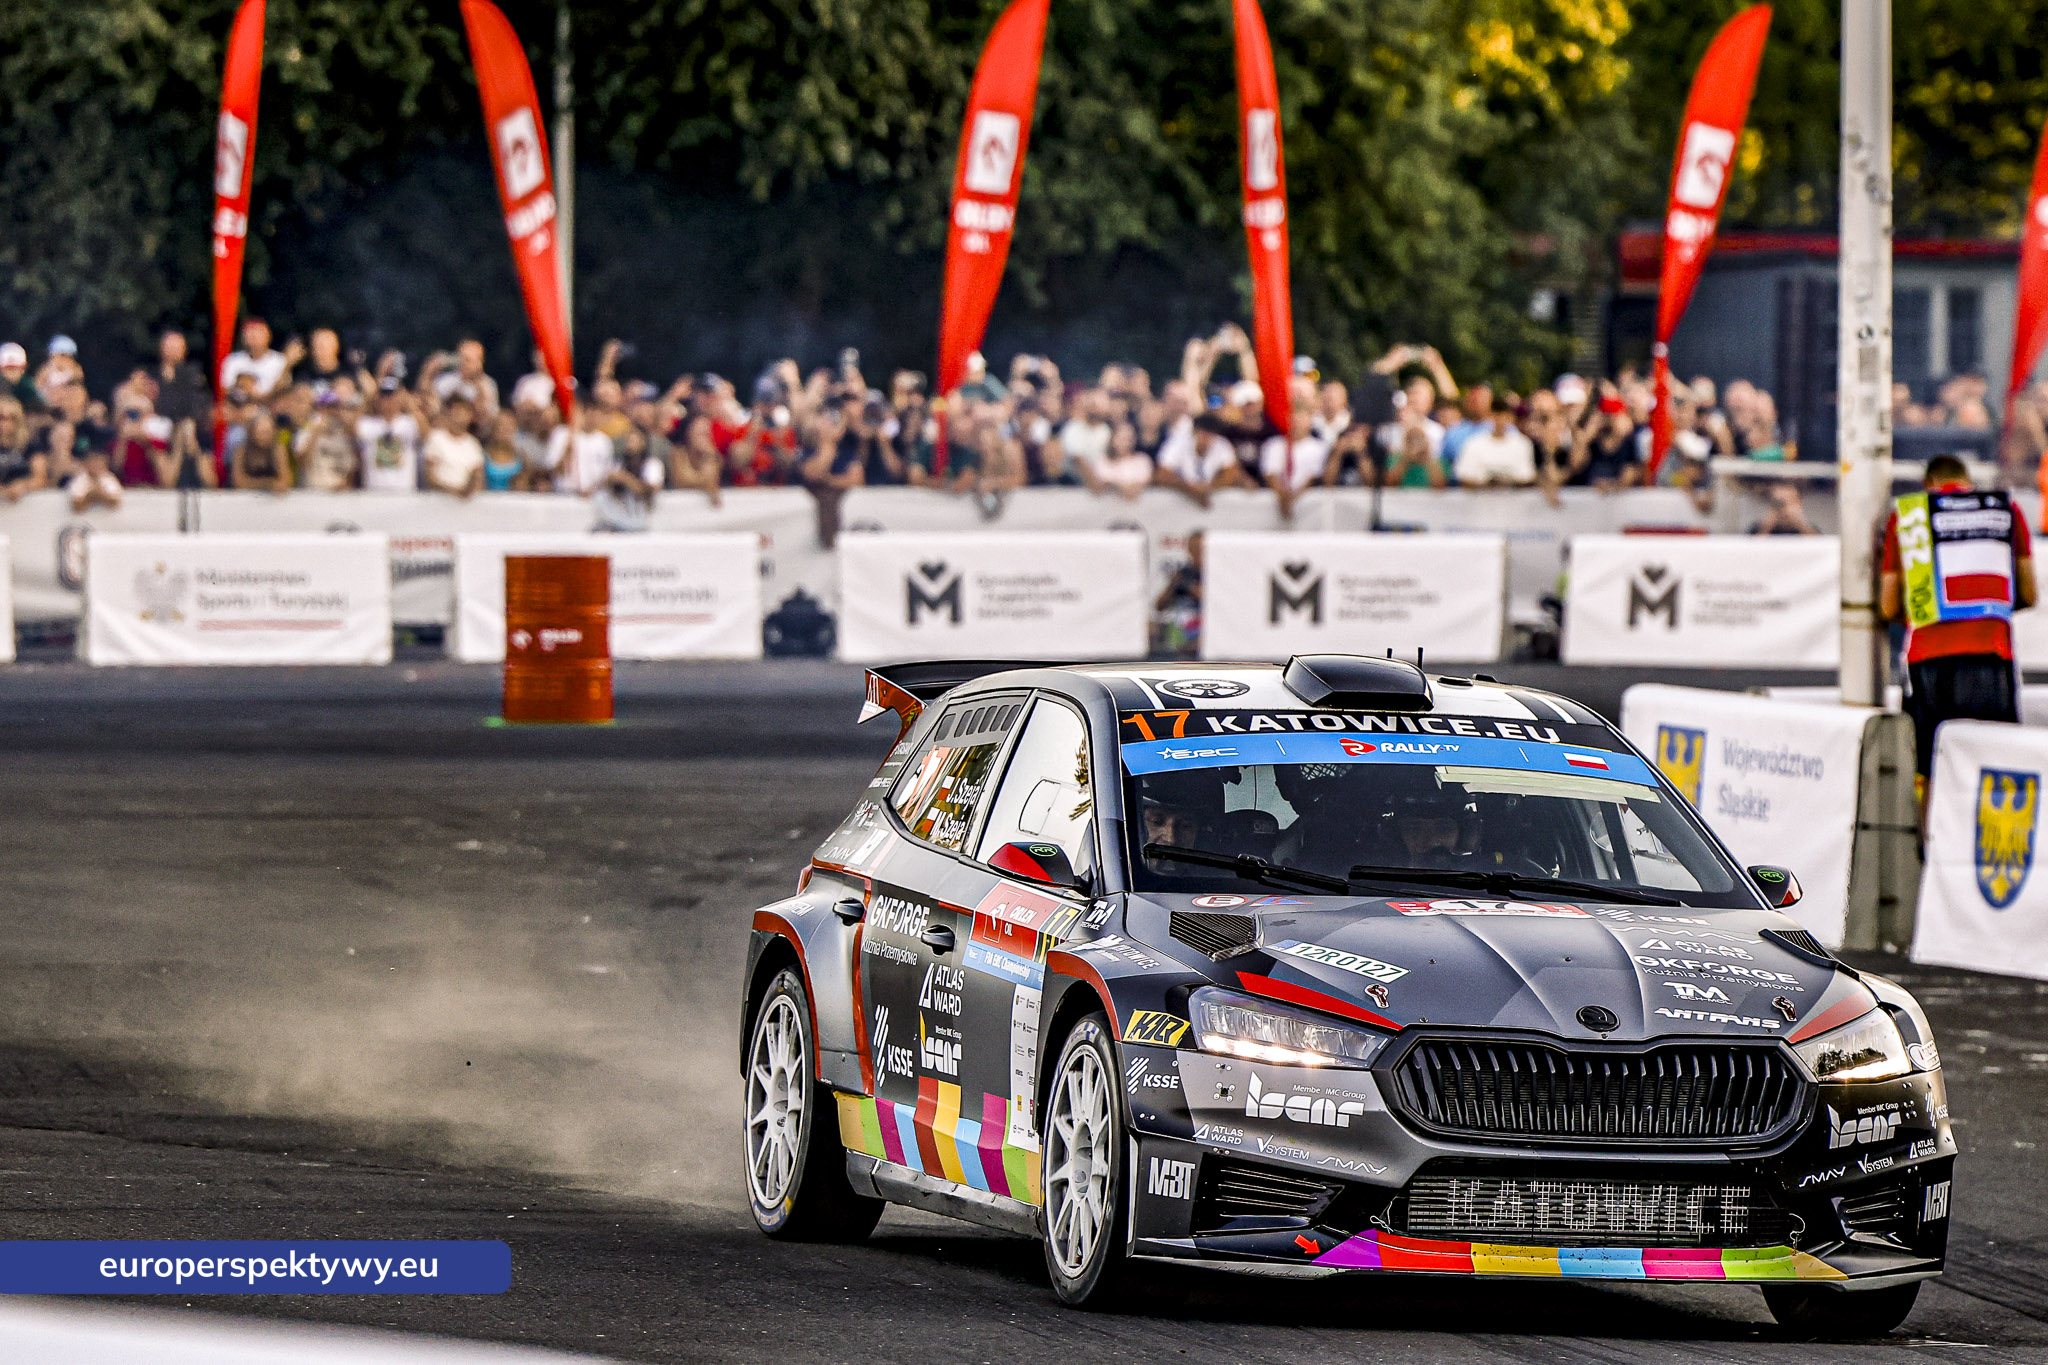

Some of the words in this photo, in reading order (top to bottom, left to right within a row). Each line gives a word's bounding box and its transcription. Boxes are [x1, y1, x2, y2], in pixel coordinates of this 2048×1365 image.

[1122, 711, 1190, 741] 17
[1206, 714, 1560, 743] KATOWICE.EU
[1721, 737, 1824, 781] Województwo
[1718, 779, 1771, 823] Śląskie
[1009, 906, 1038, 924] ORLEN
[1449, 900, 1510, 910] 17
[870, 894, 931, 939] GKFORGE
[1039, 906, 1082, 963] 17
[1674, 940, 1750, 955] ATLAS
[1679, 946, 1754, 962] WARD
[934, 964, 965, 991] ATLAS
[1633, 955, 1801, 985] GKFORGE
[1642, 967, 1697, 980] Kuźnia
[1701, 971, 1805, 993] Przemysłowa
[933, 989, 962, 1017] WARD
[1654, 1007, 1781, 1029] ANTRANS
[887, 1044, 913, 1078] KSSE
[1143, 1074, 1179, 1090] KSSE
[1325, 1088, 1341, 1096] IMC
[1341, 1090, 1366, 1100] Group
[1857, 1105, 1876, 1115] Member
[1885, 1102, 1899, 1111] Group
[1211, 1133, 1242, 1145] WARD
[1212, 1125, 1244, 1137] ATLAS
[1917, 1138, 1934, 1149] ATLAS
[1918, 1147, 1937, 1157] WARD
[1446, 1178, 1751, 1234] KATOWICE
